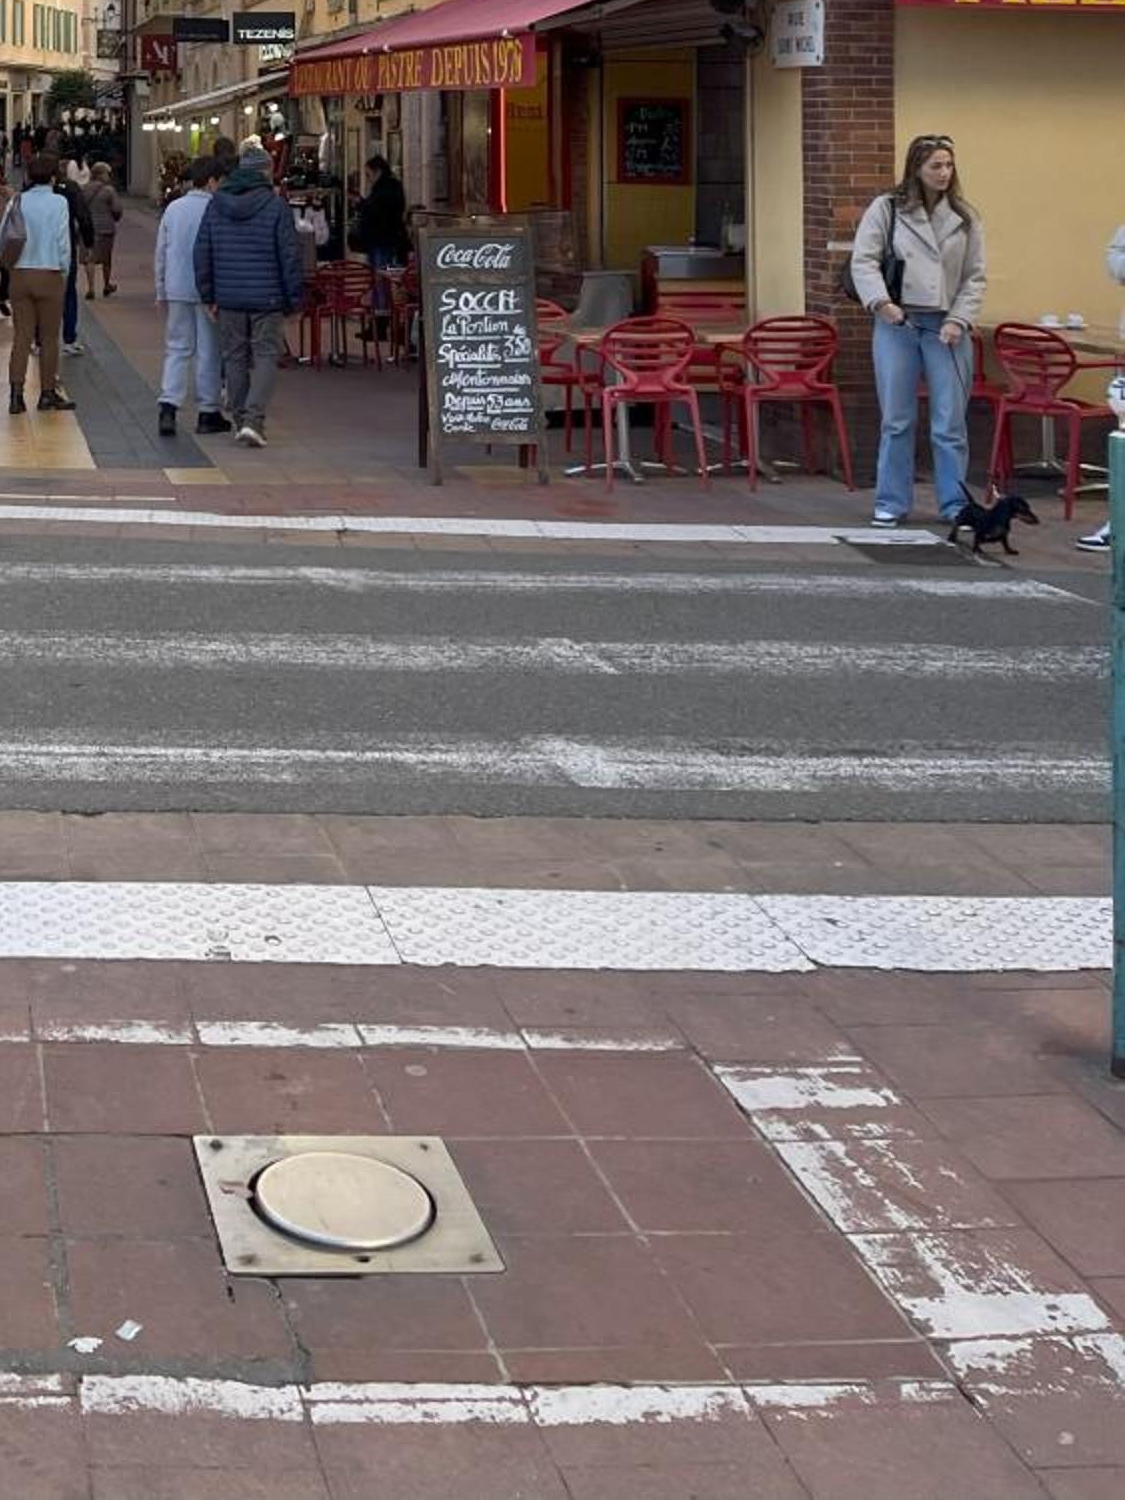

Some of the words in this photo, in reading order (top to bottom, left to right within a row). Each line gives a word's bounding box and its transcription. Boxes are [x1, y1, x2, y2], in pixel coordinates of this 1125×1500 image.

[237, 27, 294, 40] TEZENIS
[431, 43, 491, 86] DEPUIS
[437, 243, 515, 269] Coca-Cola
[439, 288, 519, 312] SOCCA
